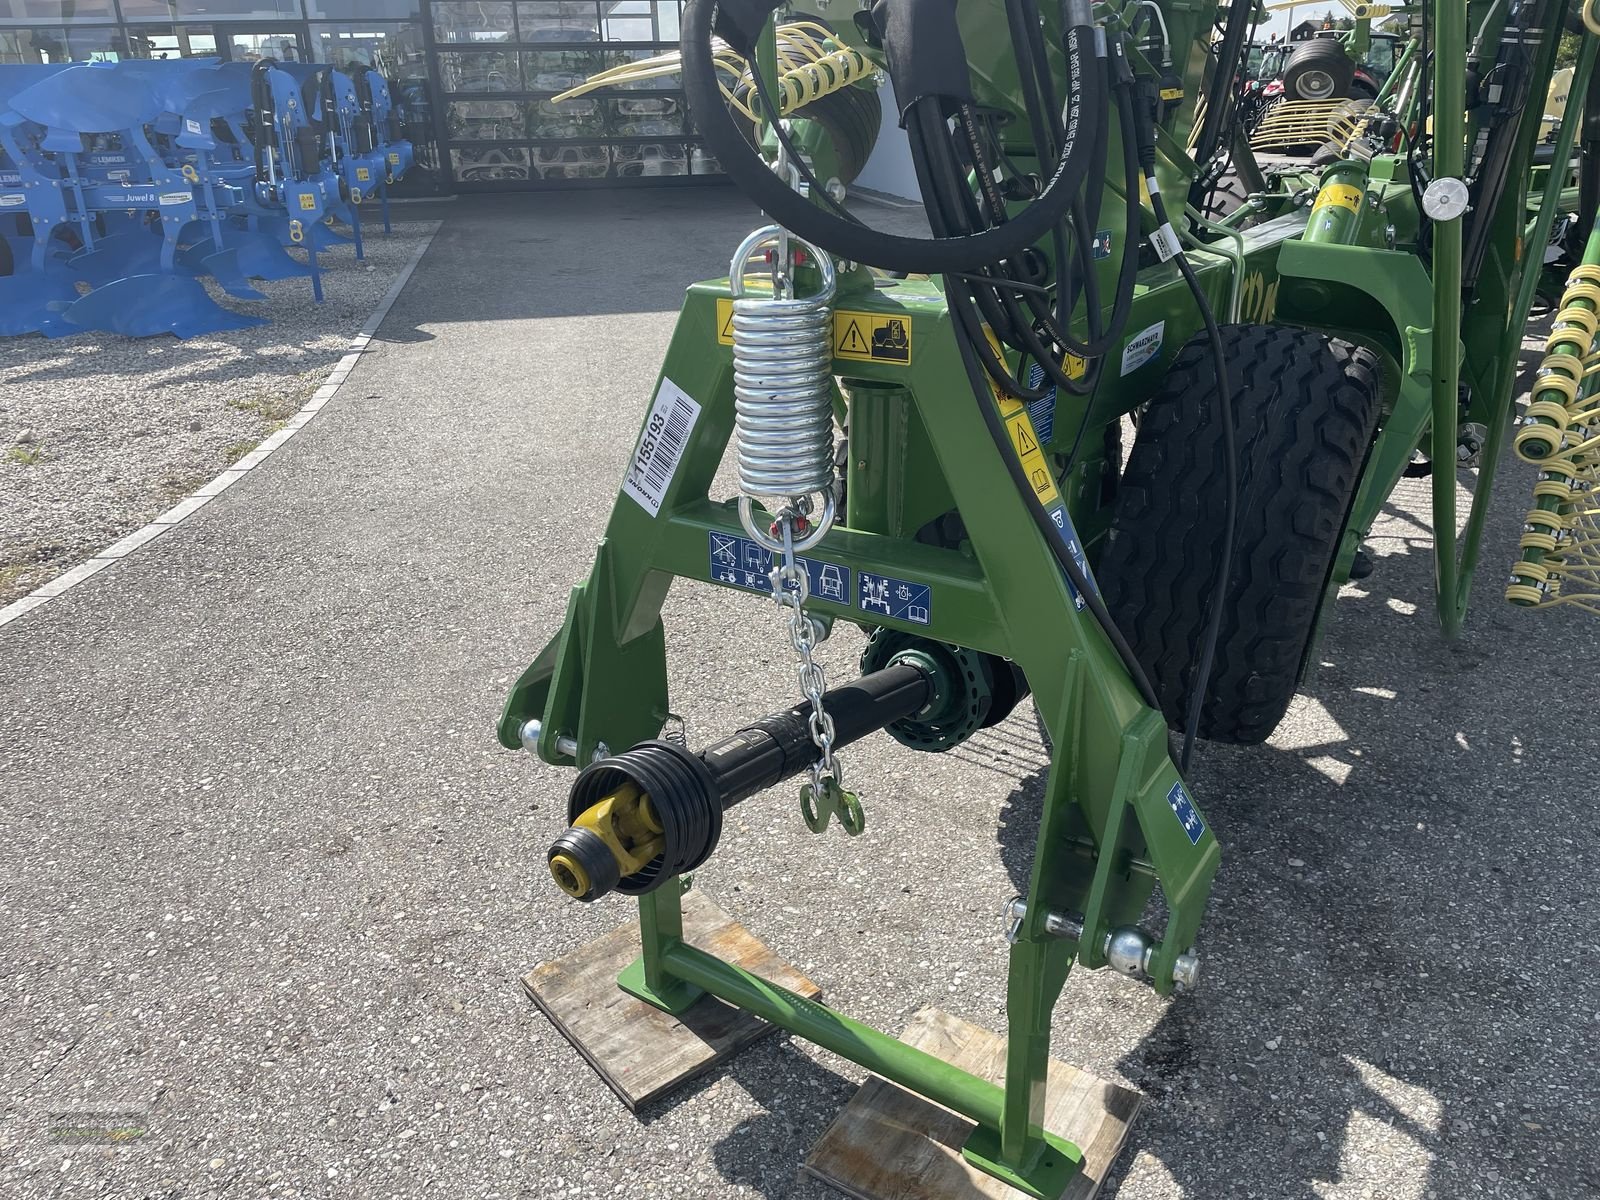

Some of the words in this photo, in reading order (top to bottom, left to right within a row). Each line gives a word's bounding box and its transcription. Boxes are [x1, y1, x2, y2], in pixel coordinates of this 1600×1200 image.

[1068, 28, 1078, 51] MSHA
[1070, 52, 1079, 69] BAR
[1071, 80, 1080, 93] WP
[126, 194, 148, 202] Juwel
[149, 194, 155, 202] 8
[1126, 332, 1159, 354] SCHWARZMAYR
[633, 413, 665, 476] 1155193
[628, 478, 653, 502] KRONE
